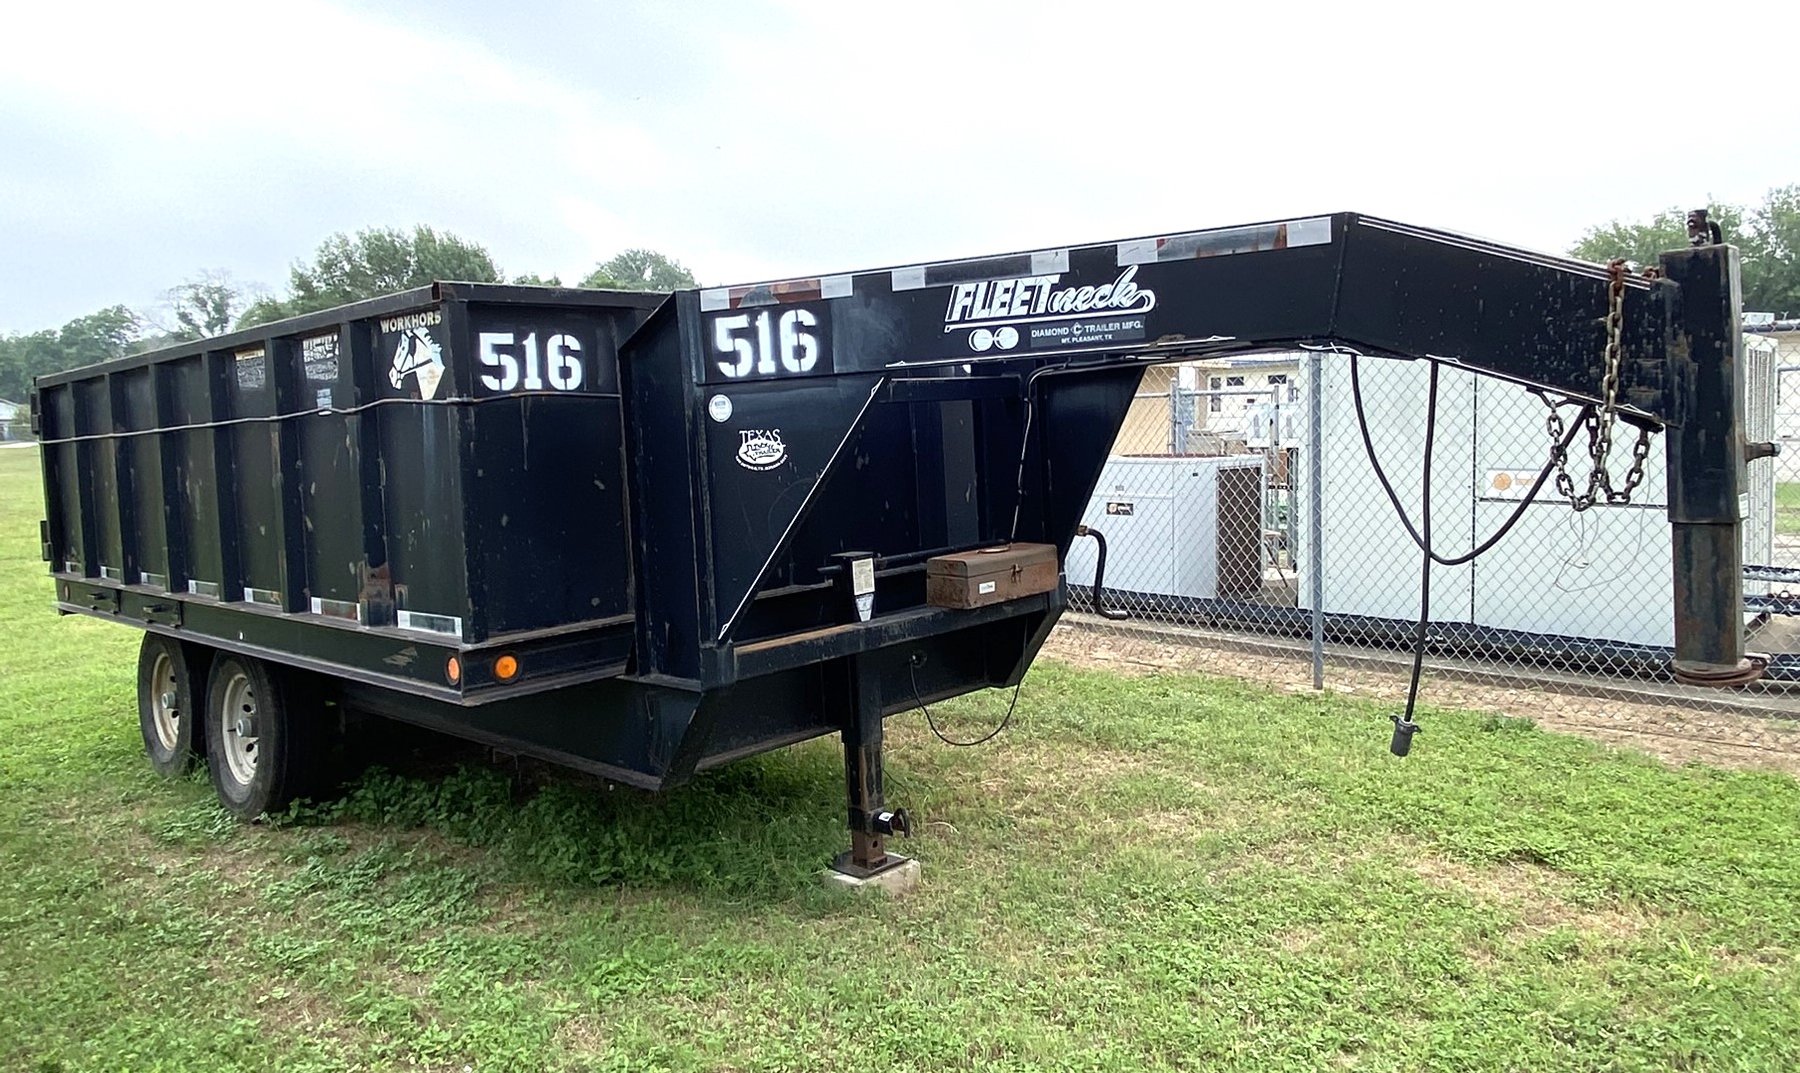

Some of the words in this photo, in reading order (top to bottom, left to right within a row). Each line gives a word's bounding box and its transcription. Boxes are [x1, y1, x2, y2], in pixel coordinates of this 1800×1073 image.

[715, 309, 817, 378] 516
[1031, 327, 1069, 338] DIAMOND
[1084, 322, 1121, 333] TRAILER
[1122, 320, 1144, 330] MFG.
[479, 331, 582, 391] 516
[739, 429, 781, 444] TEXAS
